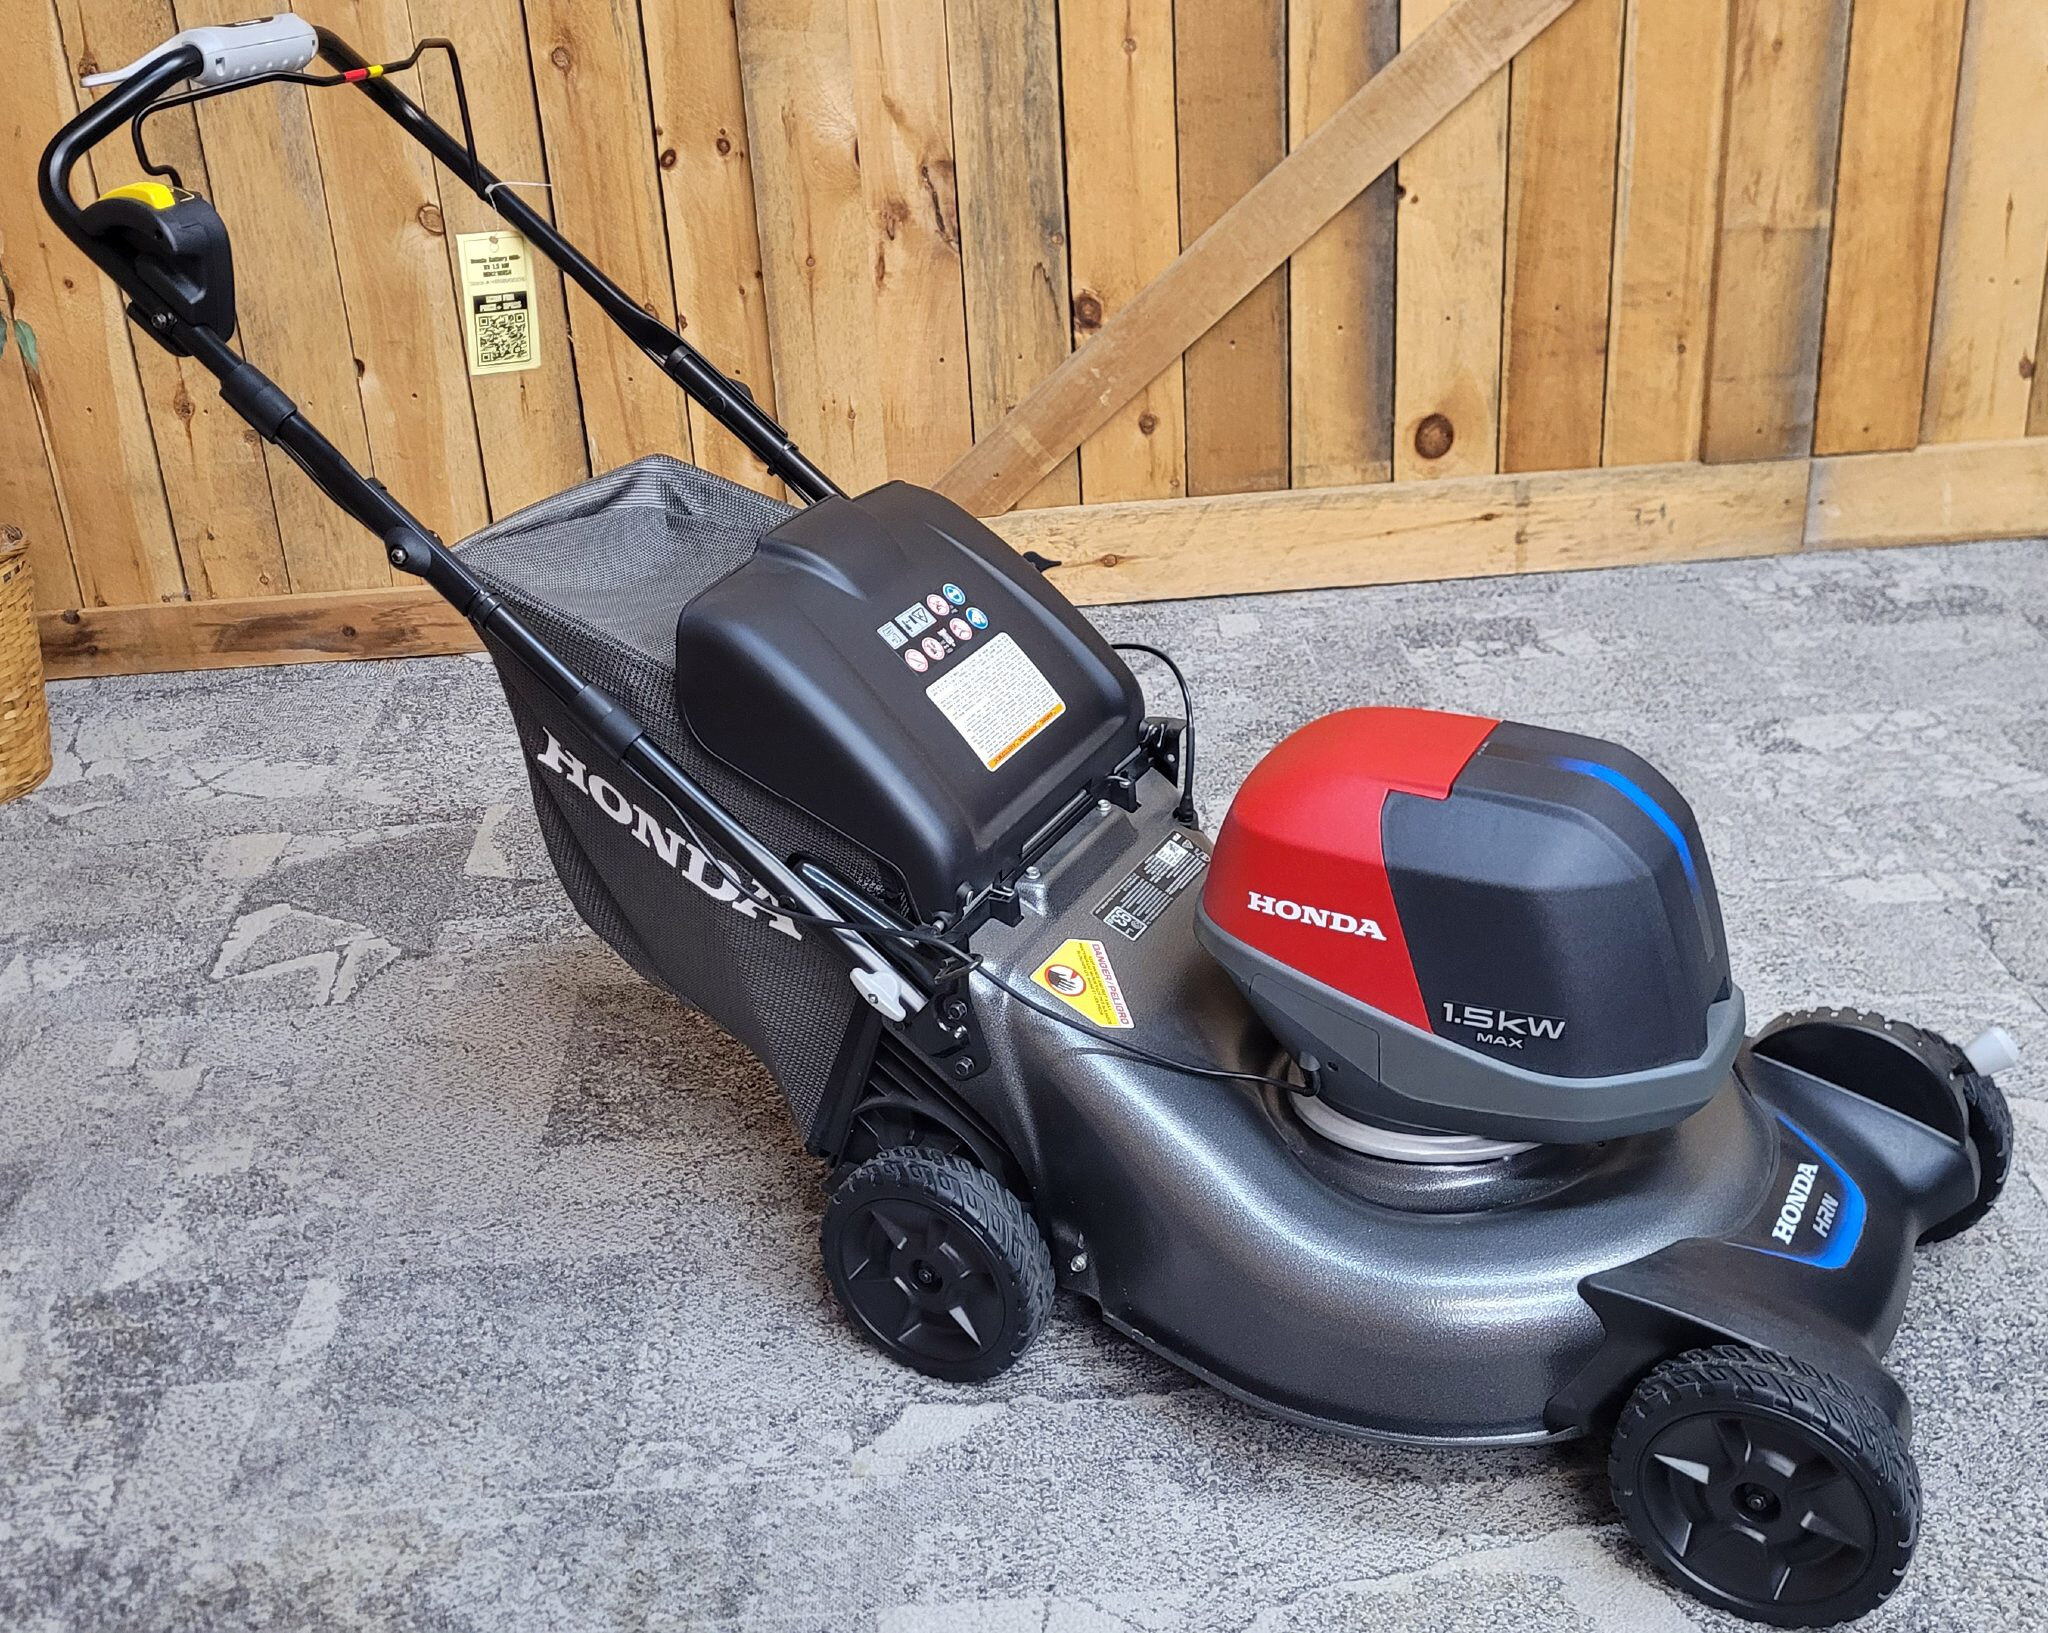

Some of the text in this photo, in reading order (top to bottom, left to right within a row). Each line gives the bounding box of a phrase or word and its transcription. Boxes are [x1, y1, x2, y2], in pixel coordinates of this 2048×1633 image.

[1247, 891, 1387, 941] HONDA
[1476, 1033, 1523, 1049] MAX
[1771, 1162, 1819, 1245] HONDA
[1812, 1192, 1839, 1238] HRN
